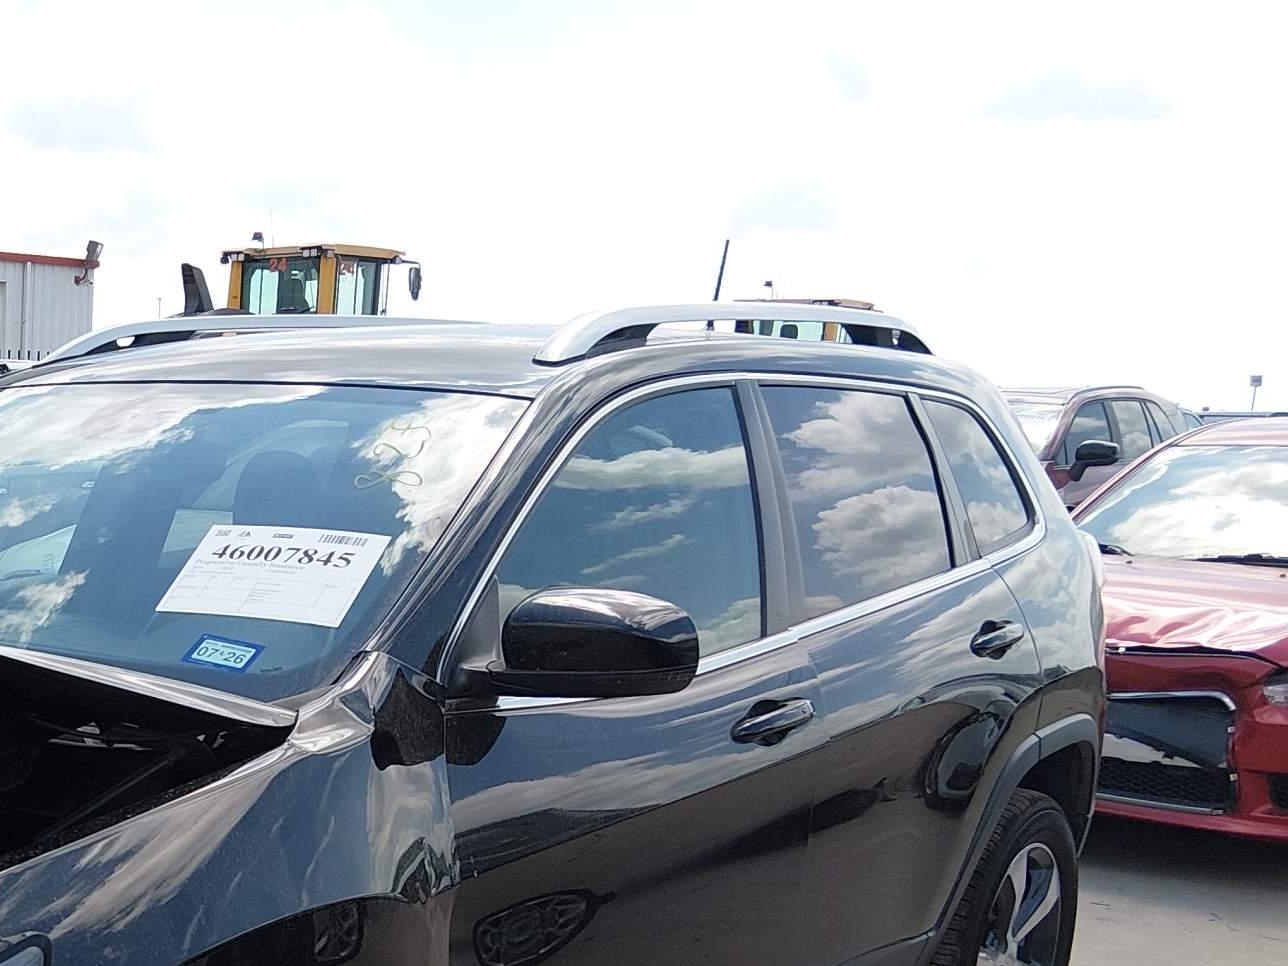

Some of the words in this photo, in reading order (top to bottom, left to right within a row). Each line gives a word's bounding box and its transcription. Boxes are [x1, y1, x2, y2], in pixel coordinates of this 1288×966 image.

[269, 257, 288, 273] 24
[339, 262, 355, 275] 24
[212, 543, 356, 569] 46007845
